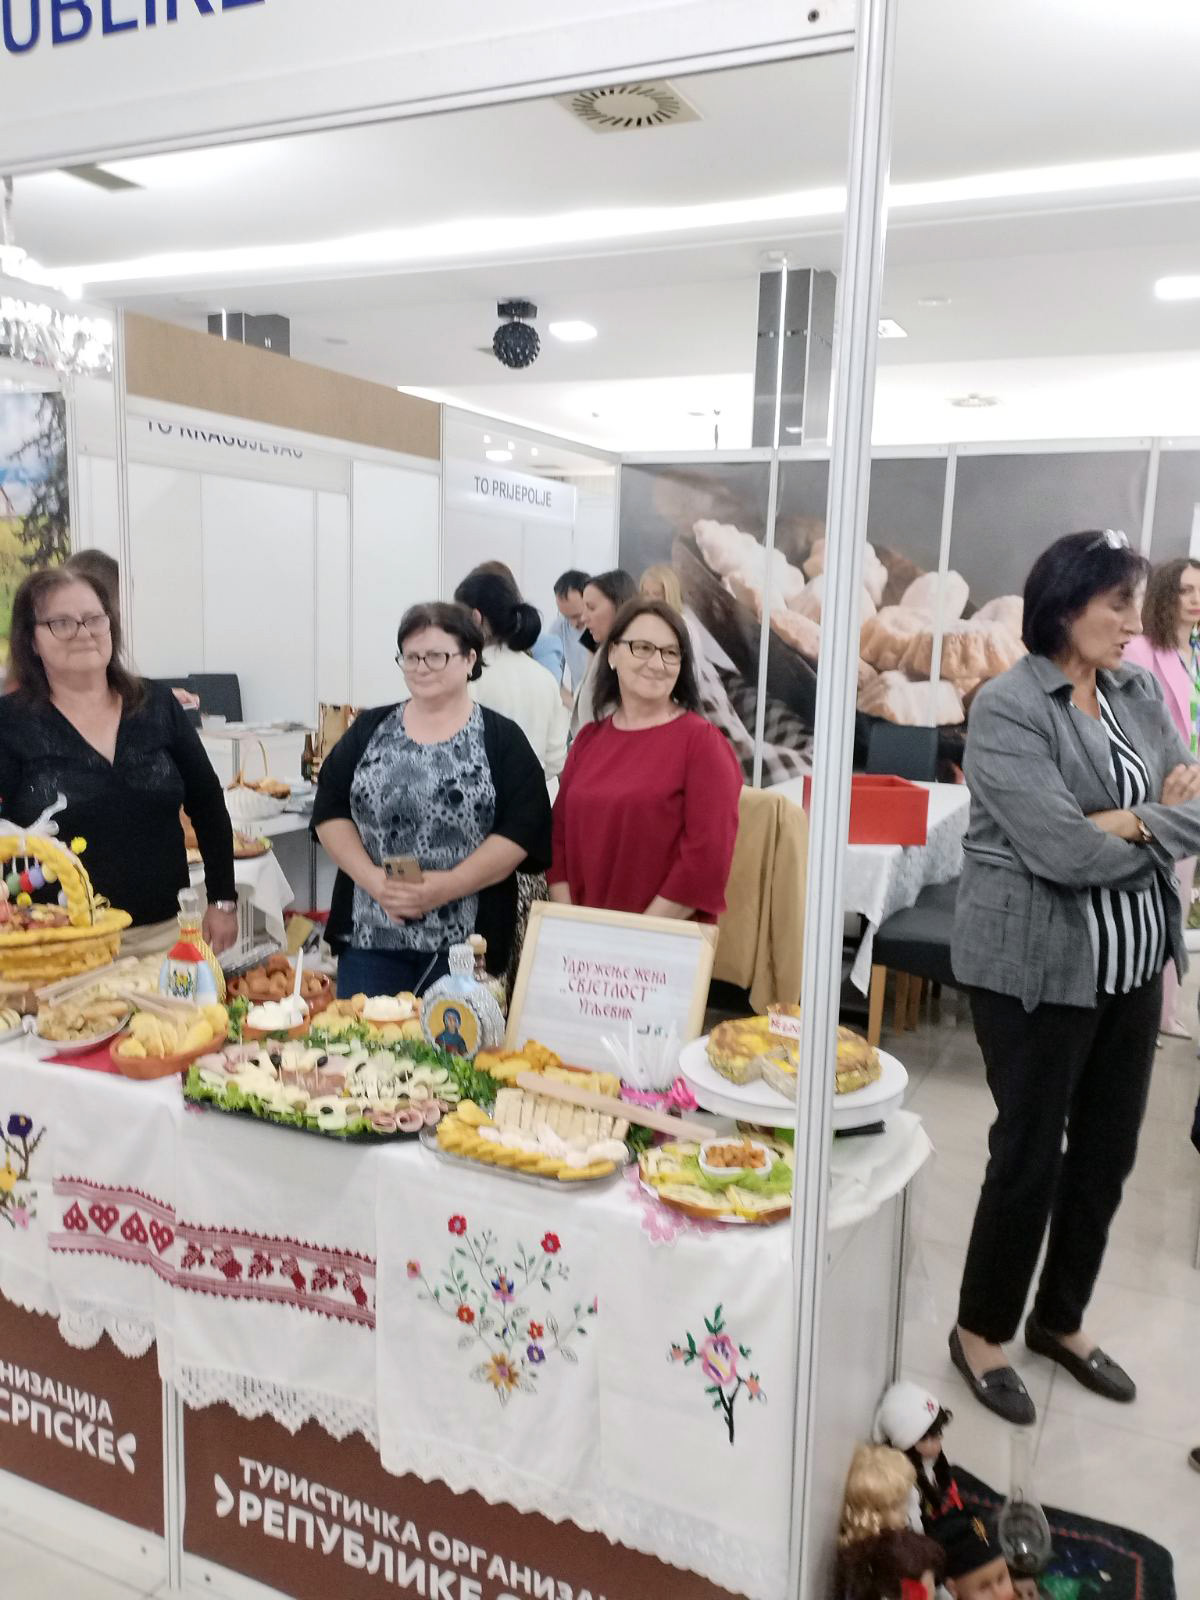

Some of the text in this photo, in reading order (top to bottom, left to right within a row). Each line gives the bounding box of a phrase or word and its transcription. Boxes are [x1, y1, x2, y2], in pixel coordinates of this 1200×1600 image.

[473, 475, 552, 508] TO PRIJEPOLJE
[238, 1455, 608, 1600] ТУРИСТИЧКА ОРГАНИЗ
[238, 1488, 484, 1600] РЕПУБЛИКЕ
